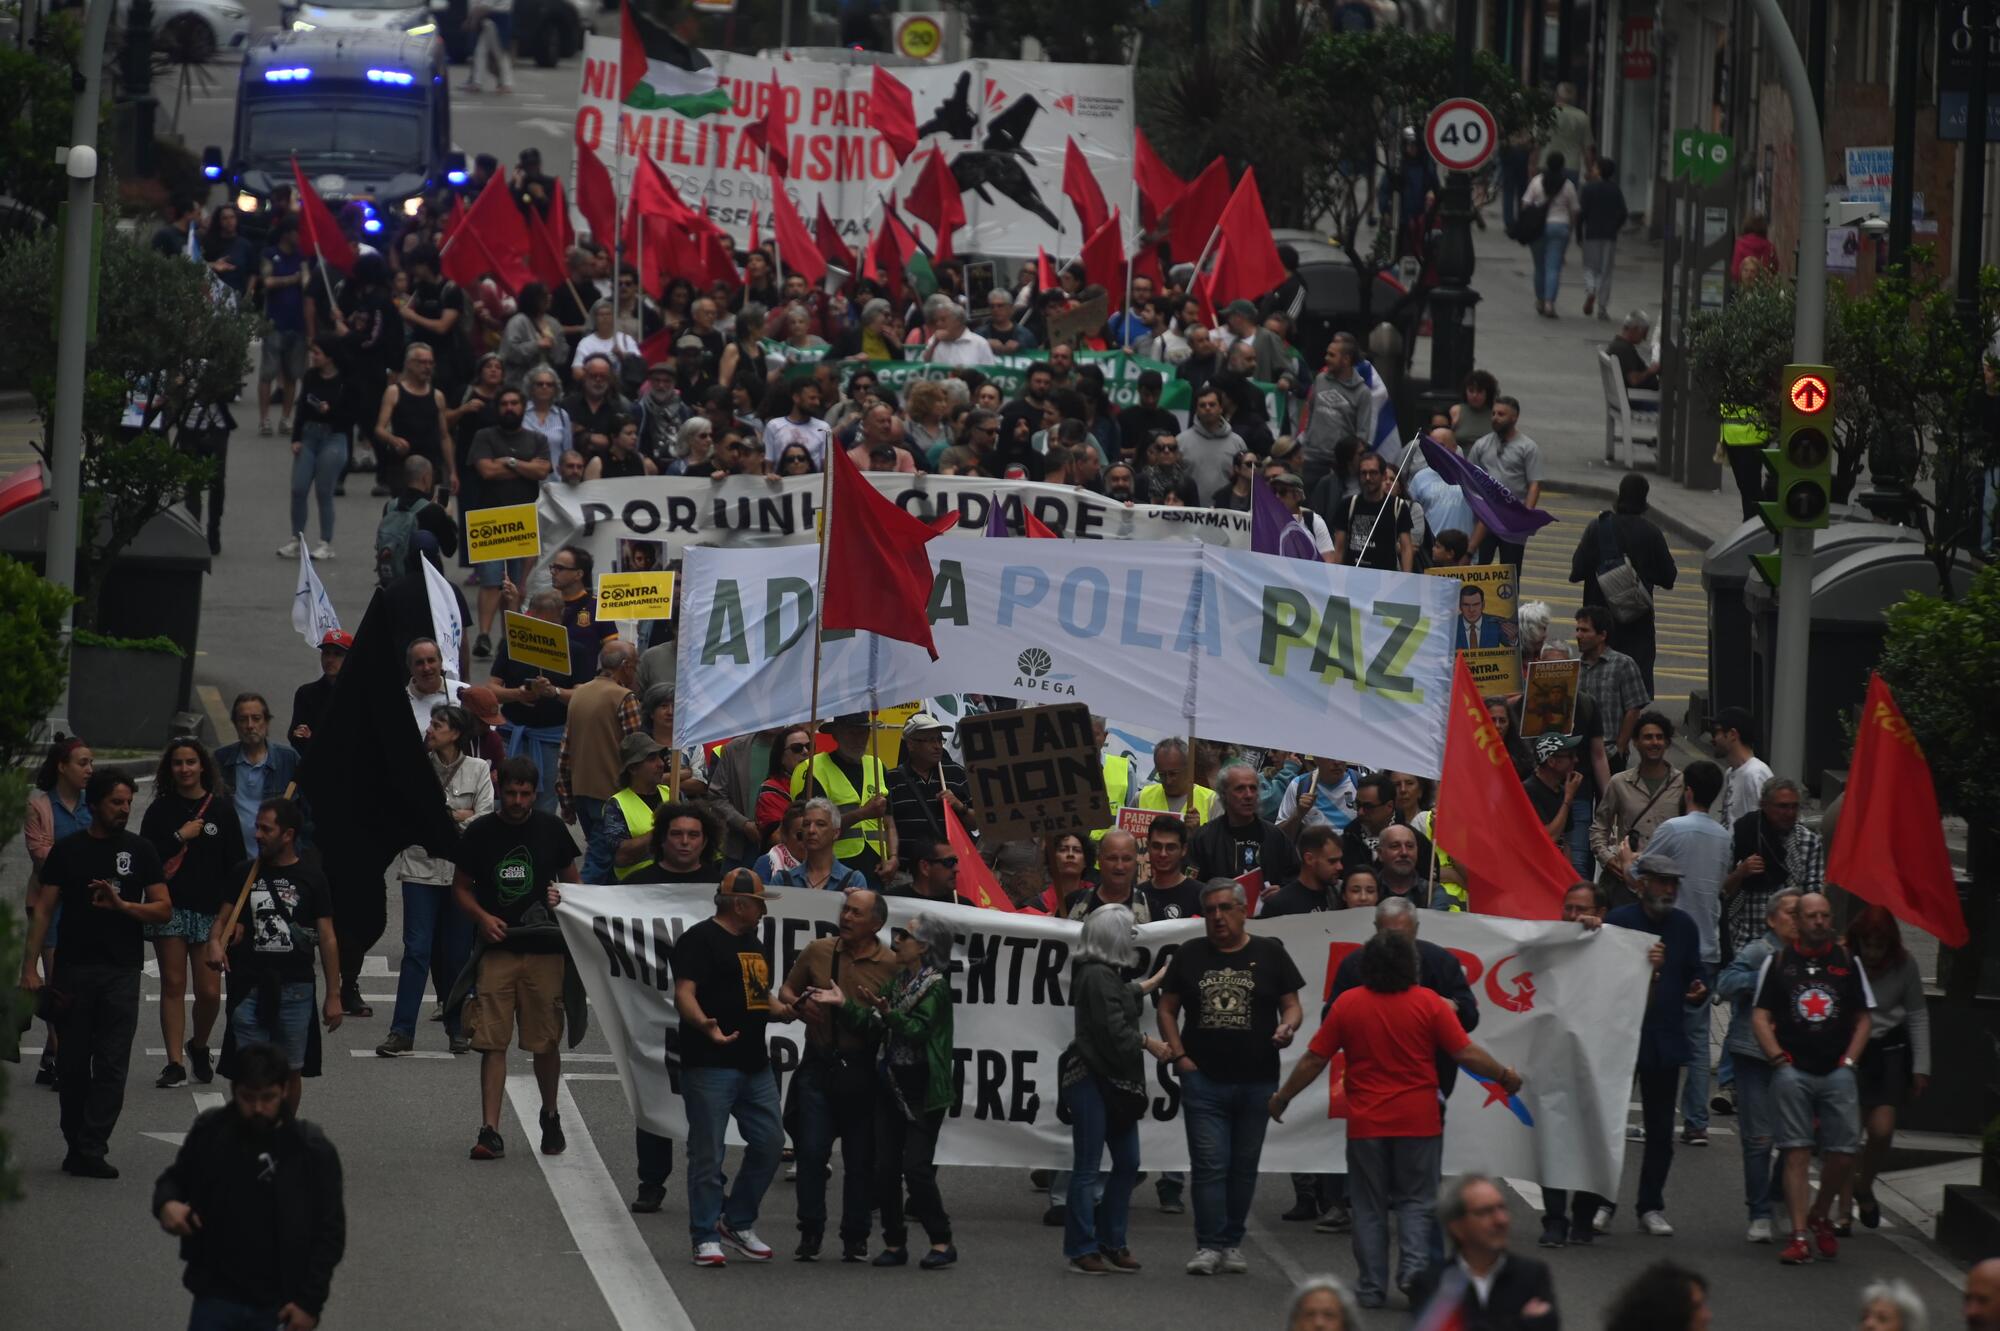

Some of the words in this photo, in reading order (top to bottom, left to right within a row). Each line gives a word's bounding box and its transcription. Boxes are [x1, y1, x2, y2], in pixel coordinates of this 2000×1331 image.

[909, 30, 933, 46] 20
[811, 87, 873, 129] PAR
[577, 105, 603, 152] O
[620, 112, 896, 183] MILITAISMO
[1439, 120, 1482, 147] 40
[580, 496, 698, 537] POR
[713, 491, 822, 536] UNH
[1148, 510, 1229, 528] DESARMA
[1232, 515, 1250, 532] VI
[601, 586, 658, 600] CONTRA
[1467, 572, 1491, 581] POLA
[1492, 570, 1510, 580] PAZ
[608, 597, 670, 608] REARMAMENTO
[700, 560, 969, 664] ADA
[997, 565, 1222, 657] POLA
[1258, 585, 1428, 702] PAZ
[1014, 676, 1075, 696] ADEGA
[959, 709, 1094, 762] OTAN
[976, 752, 1105, 807] NON
[593, 916, 683, 991] NIN
[949, 933, 1076, 1006] ENTR
[946, 1048, 1041, 1125] TRE
